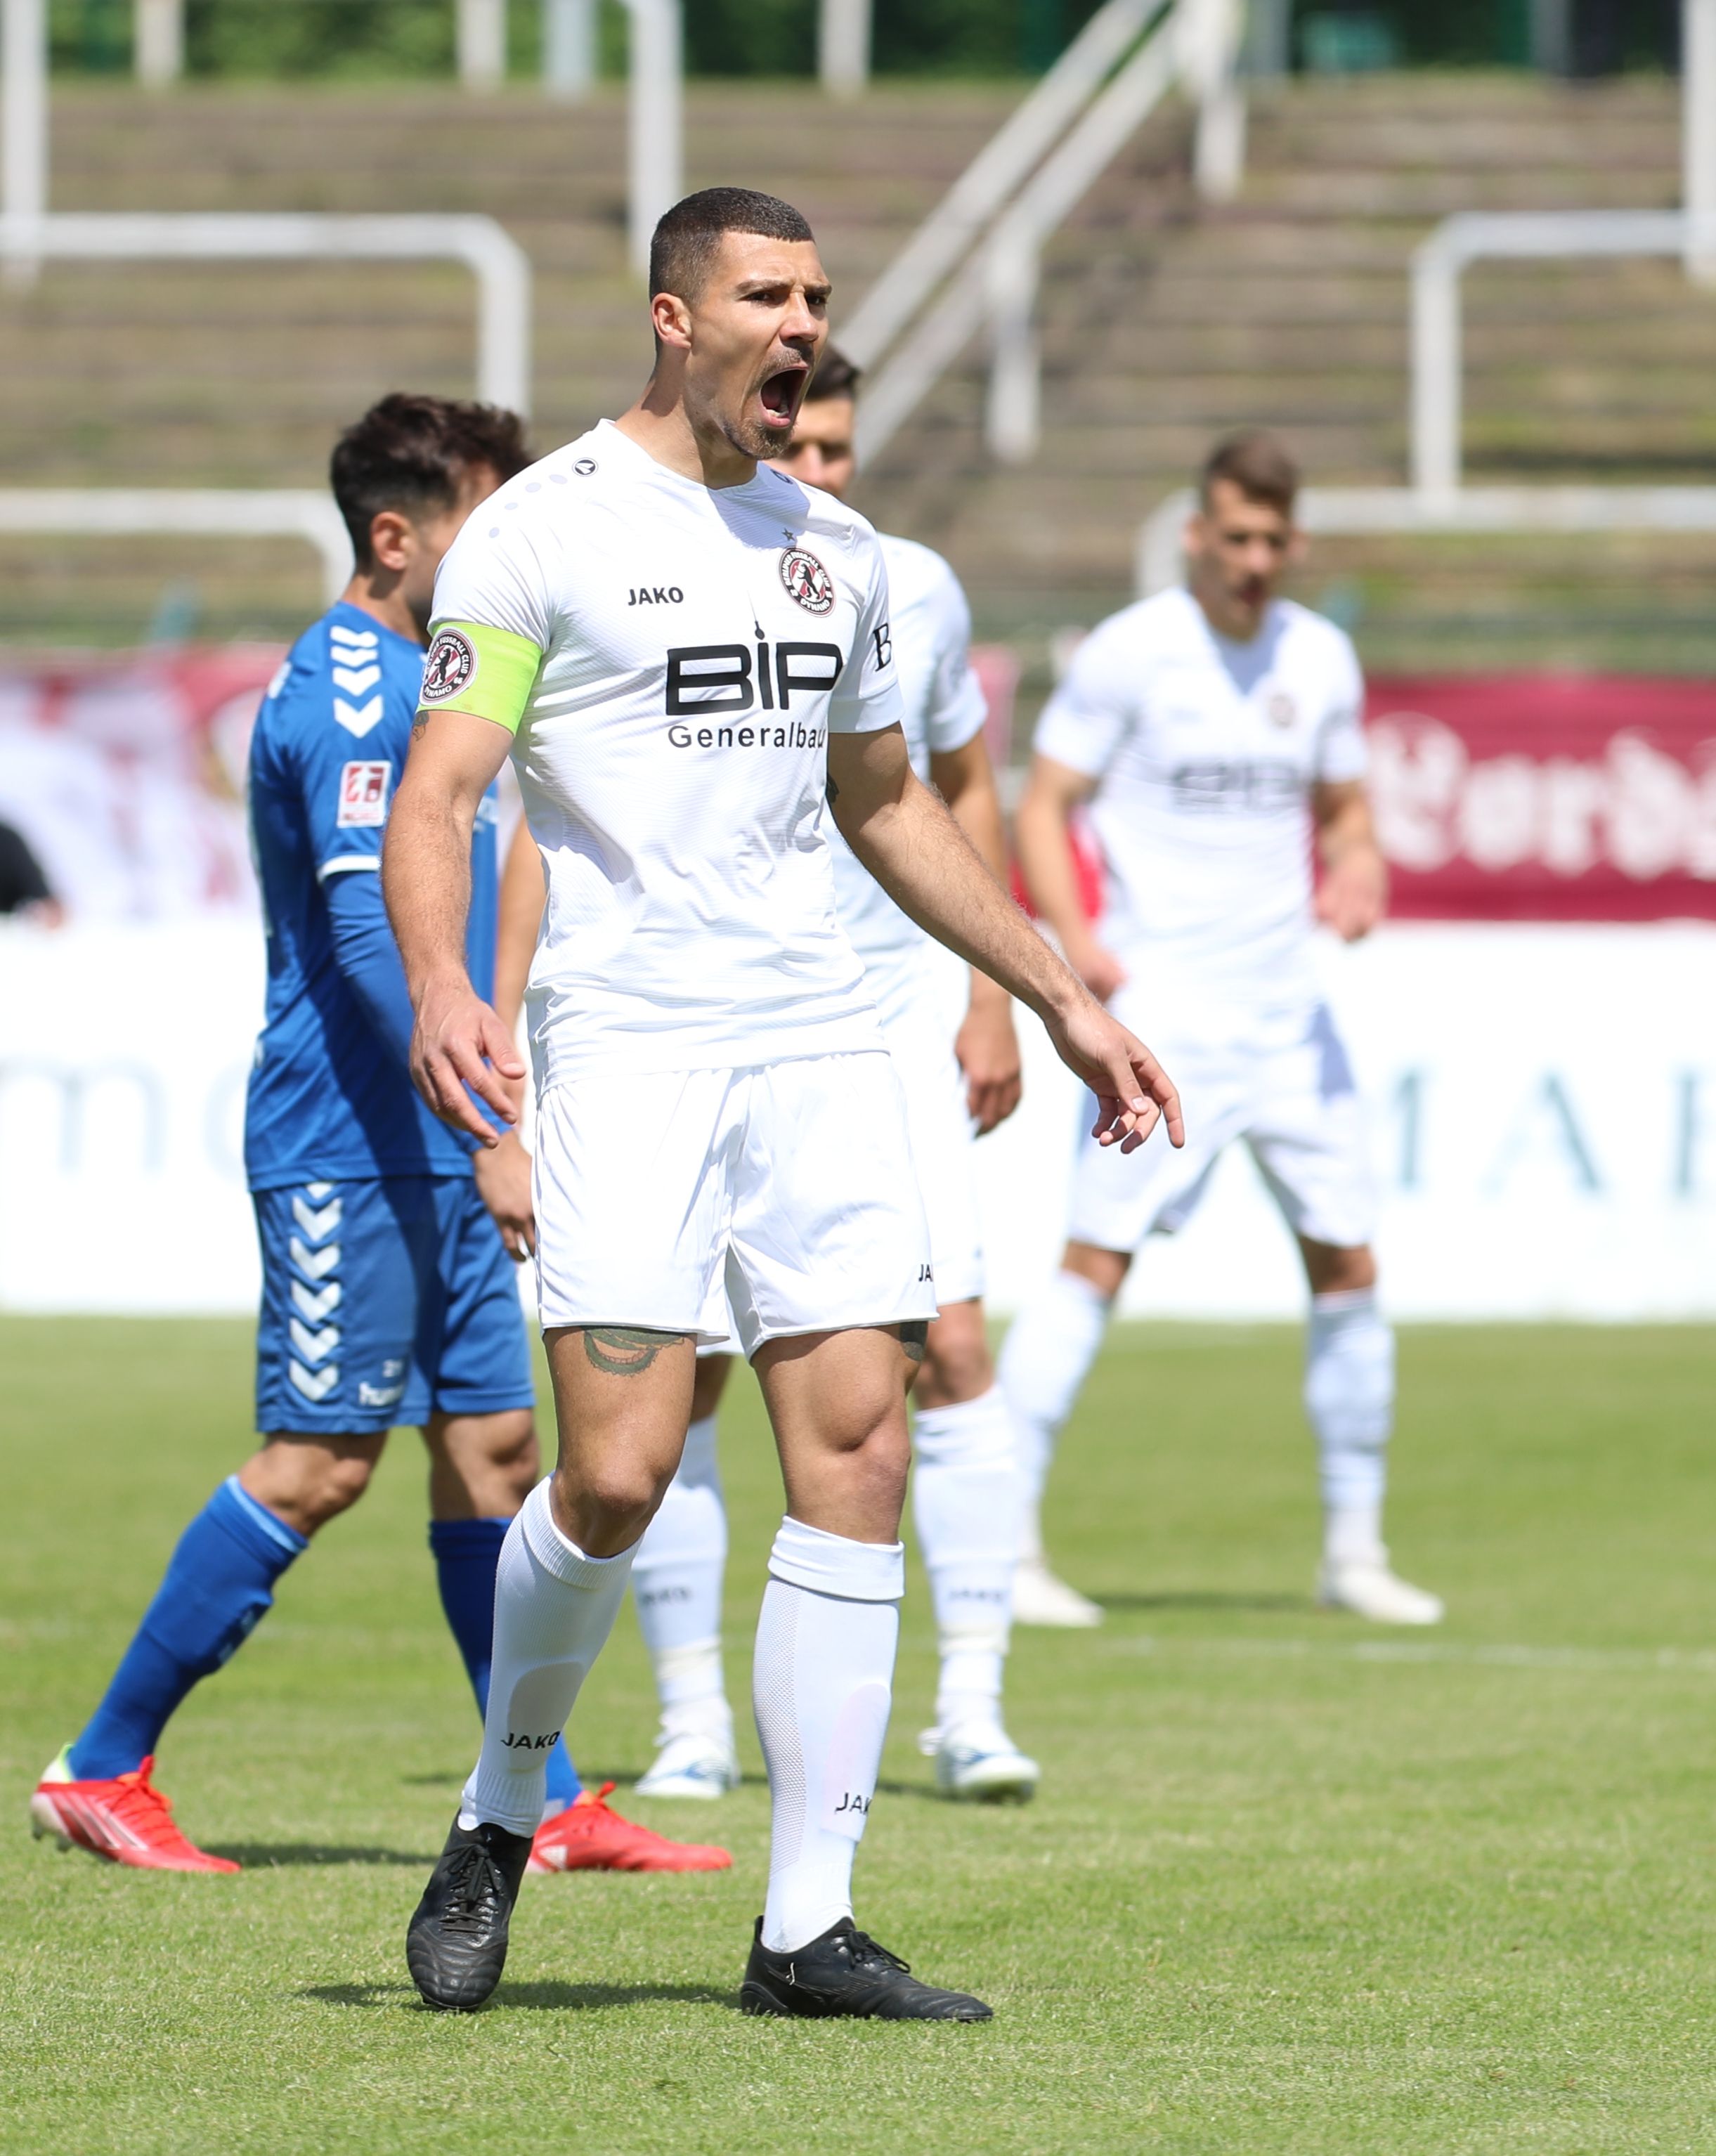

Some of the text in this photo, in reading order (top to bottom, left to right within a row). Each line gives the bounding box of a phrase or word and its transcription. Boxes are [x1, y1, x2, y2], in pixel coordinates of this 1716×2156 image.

[628, 586, 684, 606] JAKO
[439, 636, 469, 674] FUSSBALL CLUB
[668, 721, 826, 748] Generalbau
[500, 1730, 561, 1750] JAKO
